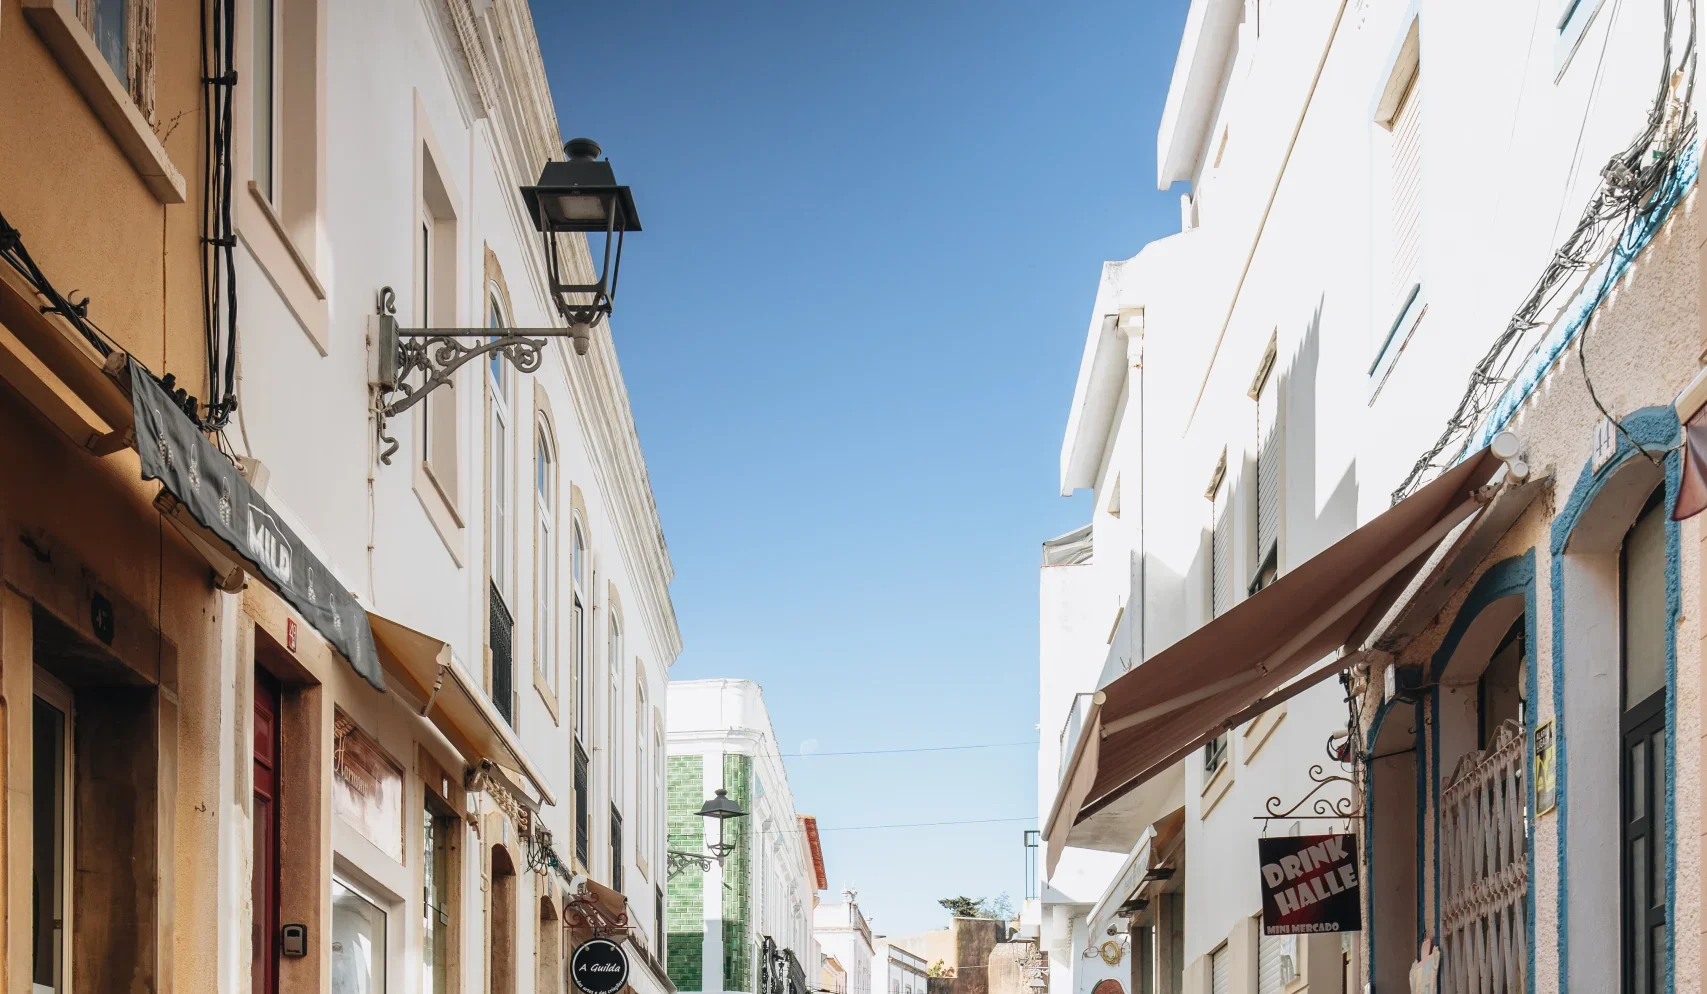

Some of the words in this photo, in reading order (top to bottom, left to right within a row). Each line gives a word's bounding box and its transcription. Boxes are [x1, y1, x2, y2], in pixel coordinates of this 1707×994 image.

[1596, 419, 1611, 458] 44
[249, 509, 290, 585] MILD
[1261, 835, 1349, 889] DRINK
[1273, 863, 1358, 917] HALLE
[1266, 924, 1290, 935] MINI
[1291, 922, 1340, 933] MERCADO
[578, 963, 587, 972] A
[590, 962, 621, 973] Guilda
